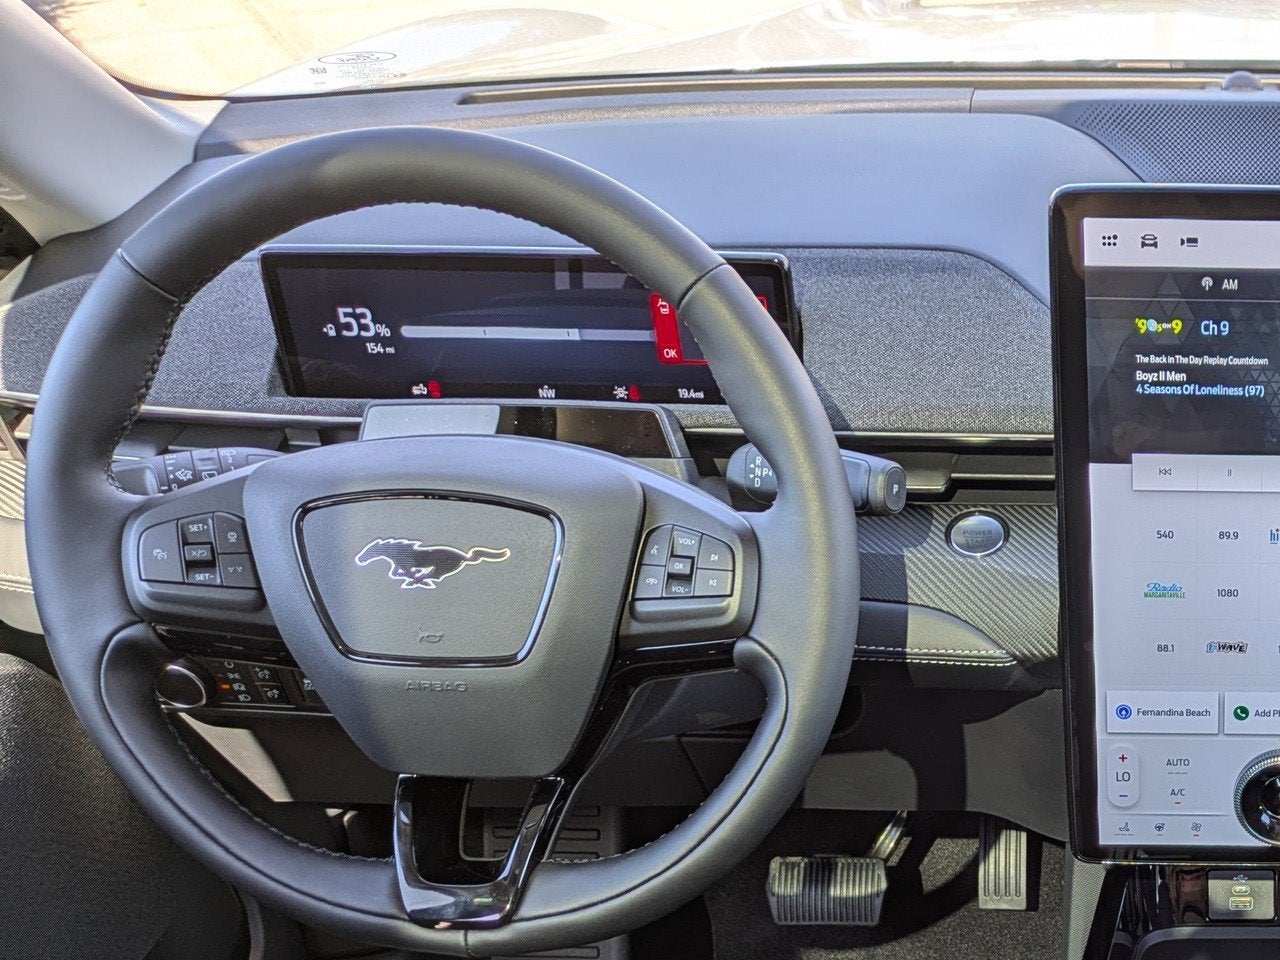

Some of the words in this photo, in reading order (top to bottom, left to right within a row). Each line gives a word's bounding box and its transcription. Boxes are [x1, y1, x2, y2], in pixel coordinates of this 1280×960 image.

[1222, 279, 1238, 290] AM
[336, 307, 391, 337] 53%
[1201, 320, 1218, 336] Ch
[1220, 321, 1229, 336] 9
[365, 342, 384, 354] 154
[385, 346, 395, 354] mi
[663, 348, 678, 359] OK
[1135, 354, 1149, 364] The
[1150, 355, 1166, 364] Back
[1175, 355, 1189, 365] The
[1189, 356, 1203, 366] Day
[1204, 356, 1228, 367] Replay
[1229, 356, 1269, 366] Countdown
[1136, 371, 1158, 383] Boyz
[1167, 371, 1187, 382] Men
[538, 388, 556, 399] NW
[1136, 383, 1143, 394] 4
[1144, 384, 1182, 395] Seasons
[1183, 384, 1195, 395] Of
[1196, 385, 1244, 396] Loneliness
[1245, 385, 1266, 398] (97)
[755, 457, 762, 466] R
[755, 468, 762, 477] N
[755, 478, 761, 487] D
[893, 485, 899, 495] P
[1156, 530, 1174, 539] 540
[1218, 531, 1239, 540] 89.9
[1146, 582, 1183, 592] Radio
[1217, 588, 1239, 598] 1080
[1157, 644, 1175, 653] 88.1
[405, 680, 468, 692] AIRBAG
[1136, 707, 1184, 717] Fernandina
[1185, 708, 1211, 718] Beach
[1254, 709, 1272, 718] Add
[1165, 758, 1190, 767] AUTO
[1115, 771, 1131, 782] LO
[1170, 788, 1186, 797] A/C
